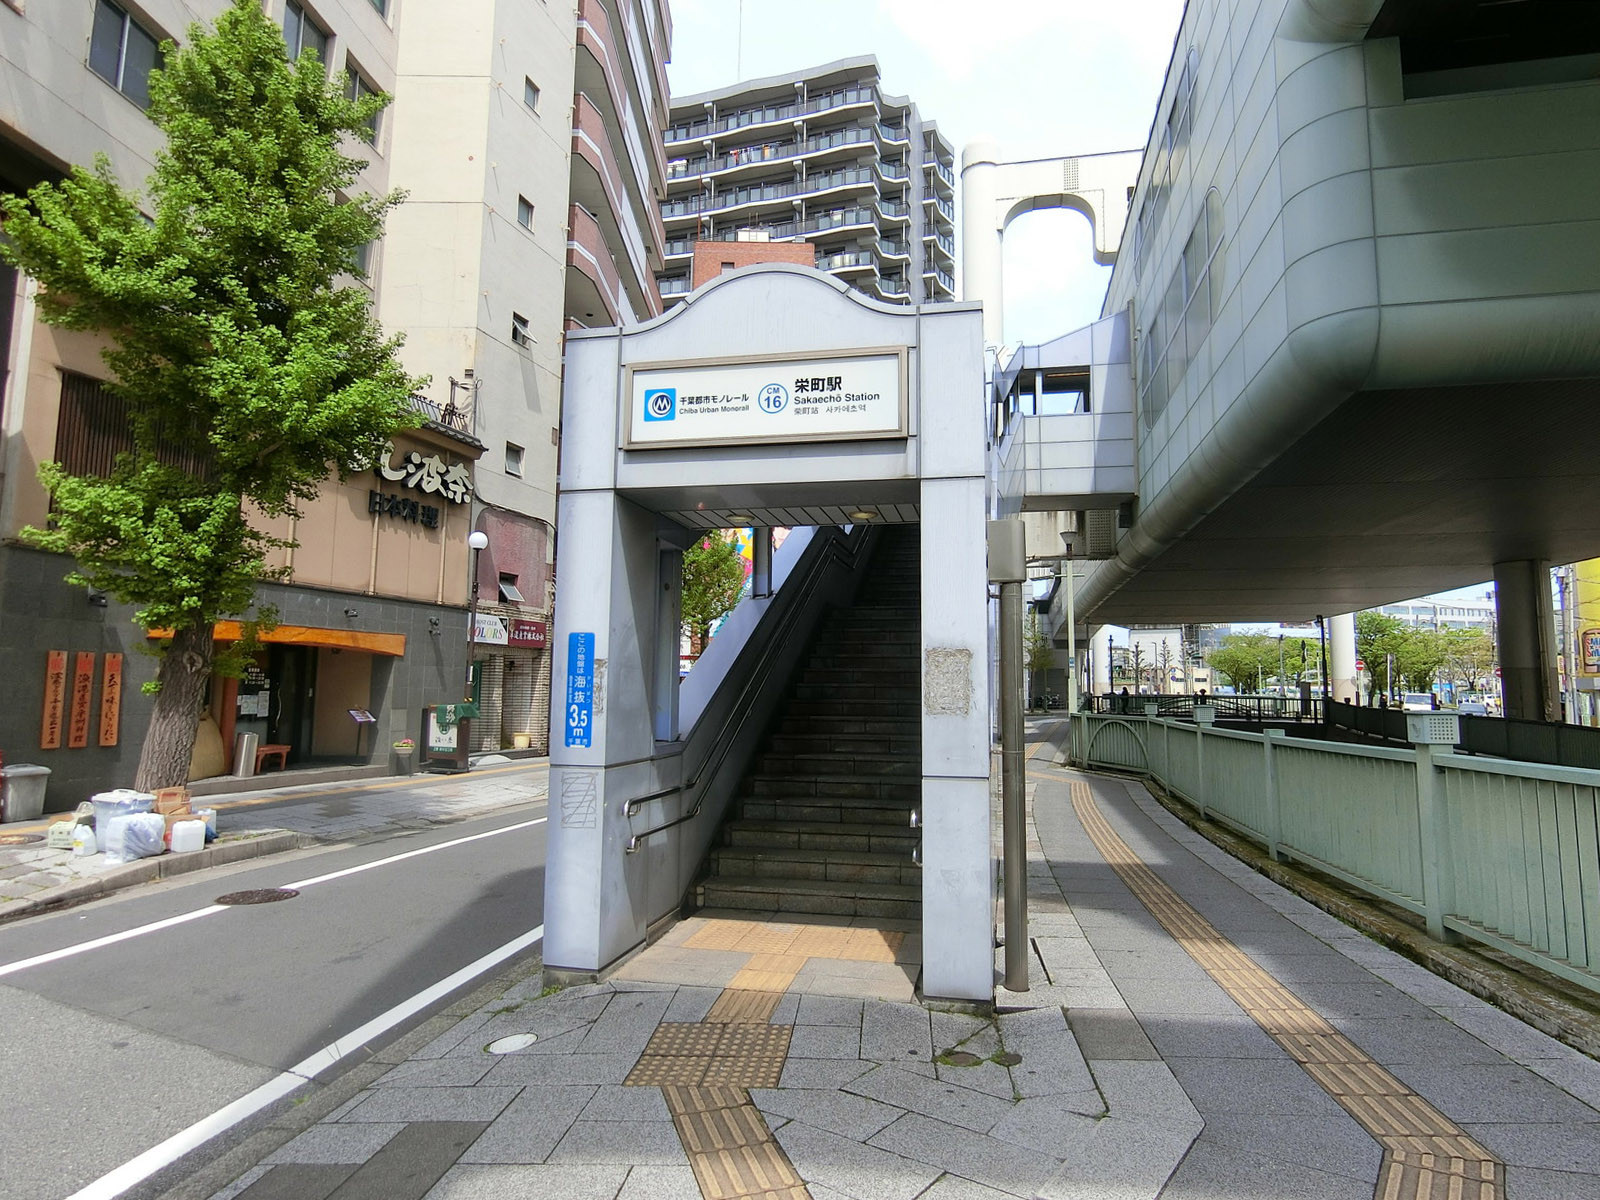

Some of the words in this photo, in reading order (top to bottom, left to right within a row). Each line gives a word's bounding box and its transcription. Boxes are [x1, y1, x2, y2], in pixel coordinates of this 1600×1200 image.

[794, 376, 842, 393] 栄町駅
[680, 394, 749, 406] 千葉都市モノレール
[764, 395, 782, 408] 16
[794, 394, 842, 405] Sakaechō
[844, 392, 880, 402] Station
[721, 404, 749, 412] Monorail
[826, 404, 866, 414] 사카에초역
[369, 490, 440, 529] 日本料理
[467, 626, 504, 640] OLORS
[574, 676, 586, 703] 海抜
[569, 704, 588, 727] 3.5
[573, 728, 583, 736] m
